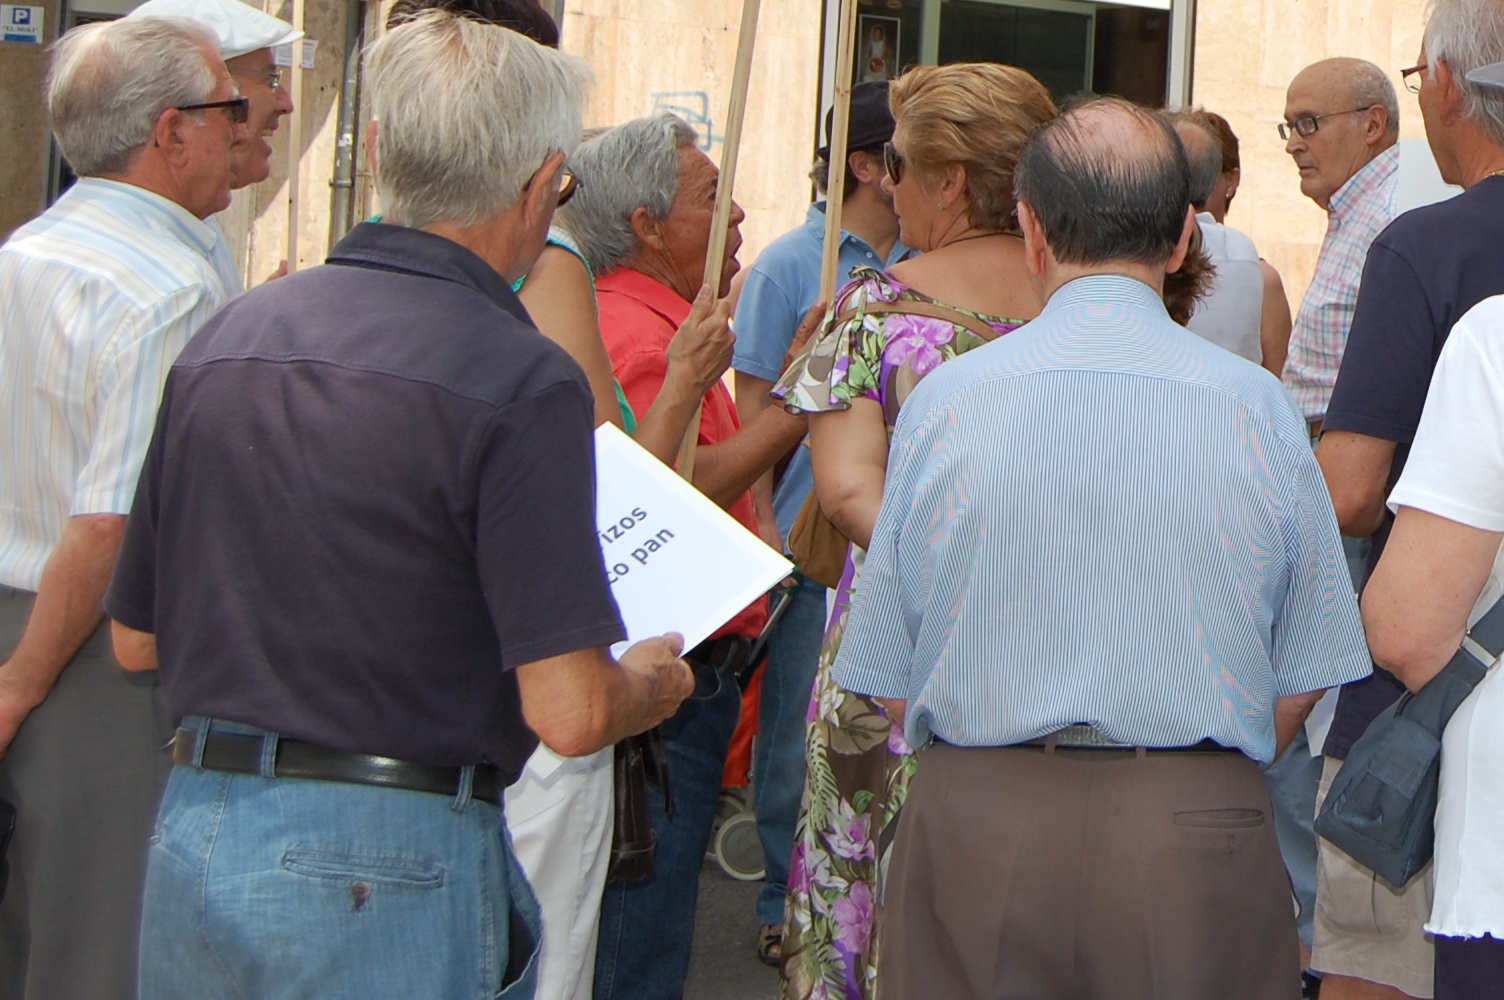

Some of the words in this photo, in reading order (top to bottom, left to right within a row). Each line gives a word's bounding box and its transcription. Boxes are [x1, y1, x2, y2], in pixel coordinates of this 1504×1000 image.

[15, 9, 28, 23] P
[599, 506, 648, 547] izos
[630, 528, 675, 566] pan
